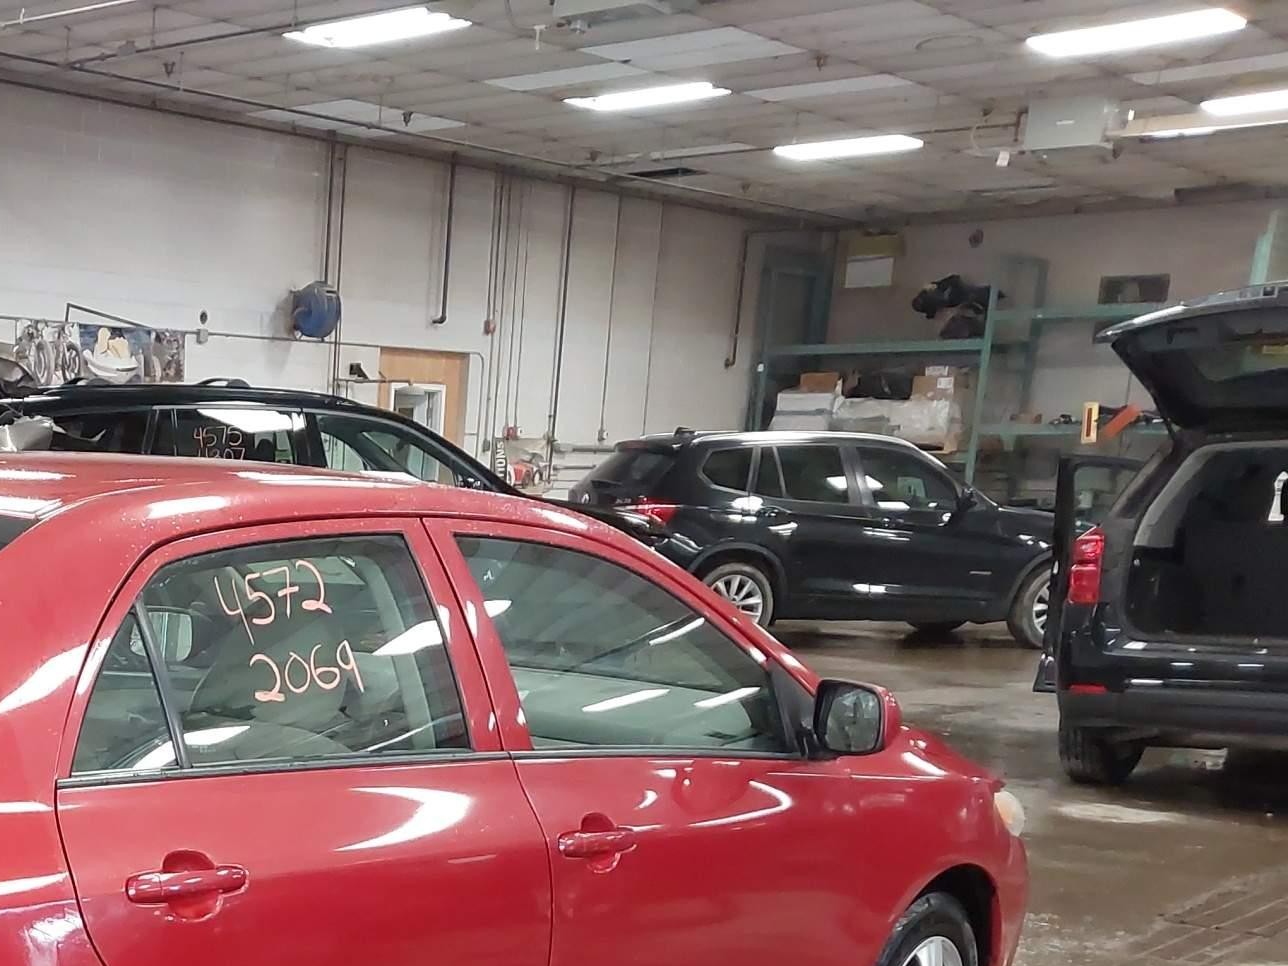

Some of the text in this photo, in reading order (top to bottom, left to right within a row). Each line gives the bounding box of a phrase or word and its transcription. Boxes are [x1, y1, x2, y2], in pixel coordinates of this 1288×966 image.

[193, 425, 243, 449] 4575
[214, 560, 333, 646] 4572
[249, 639, 364, 701] 2069
